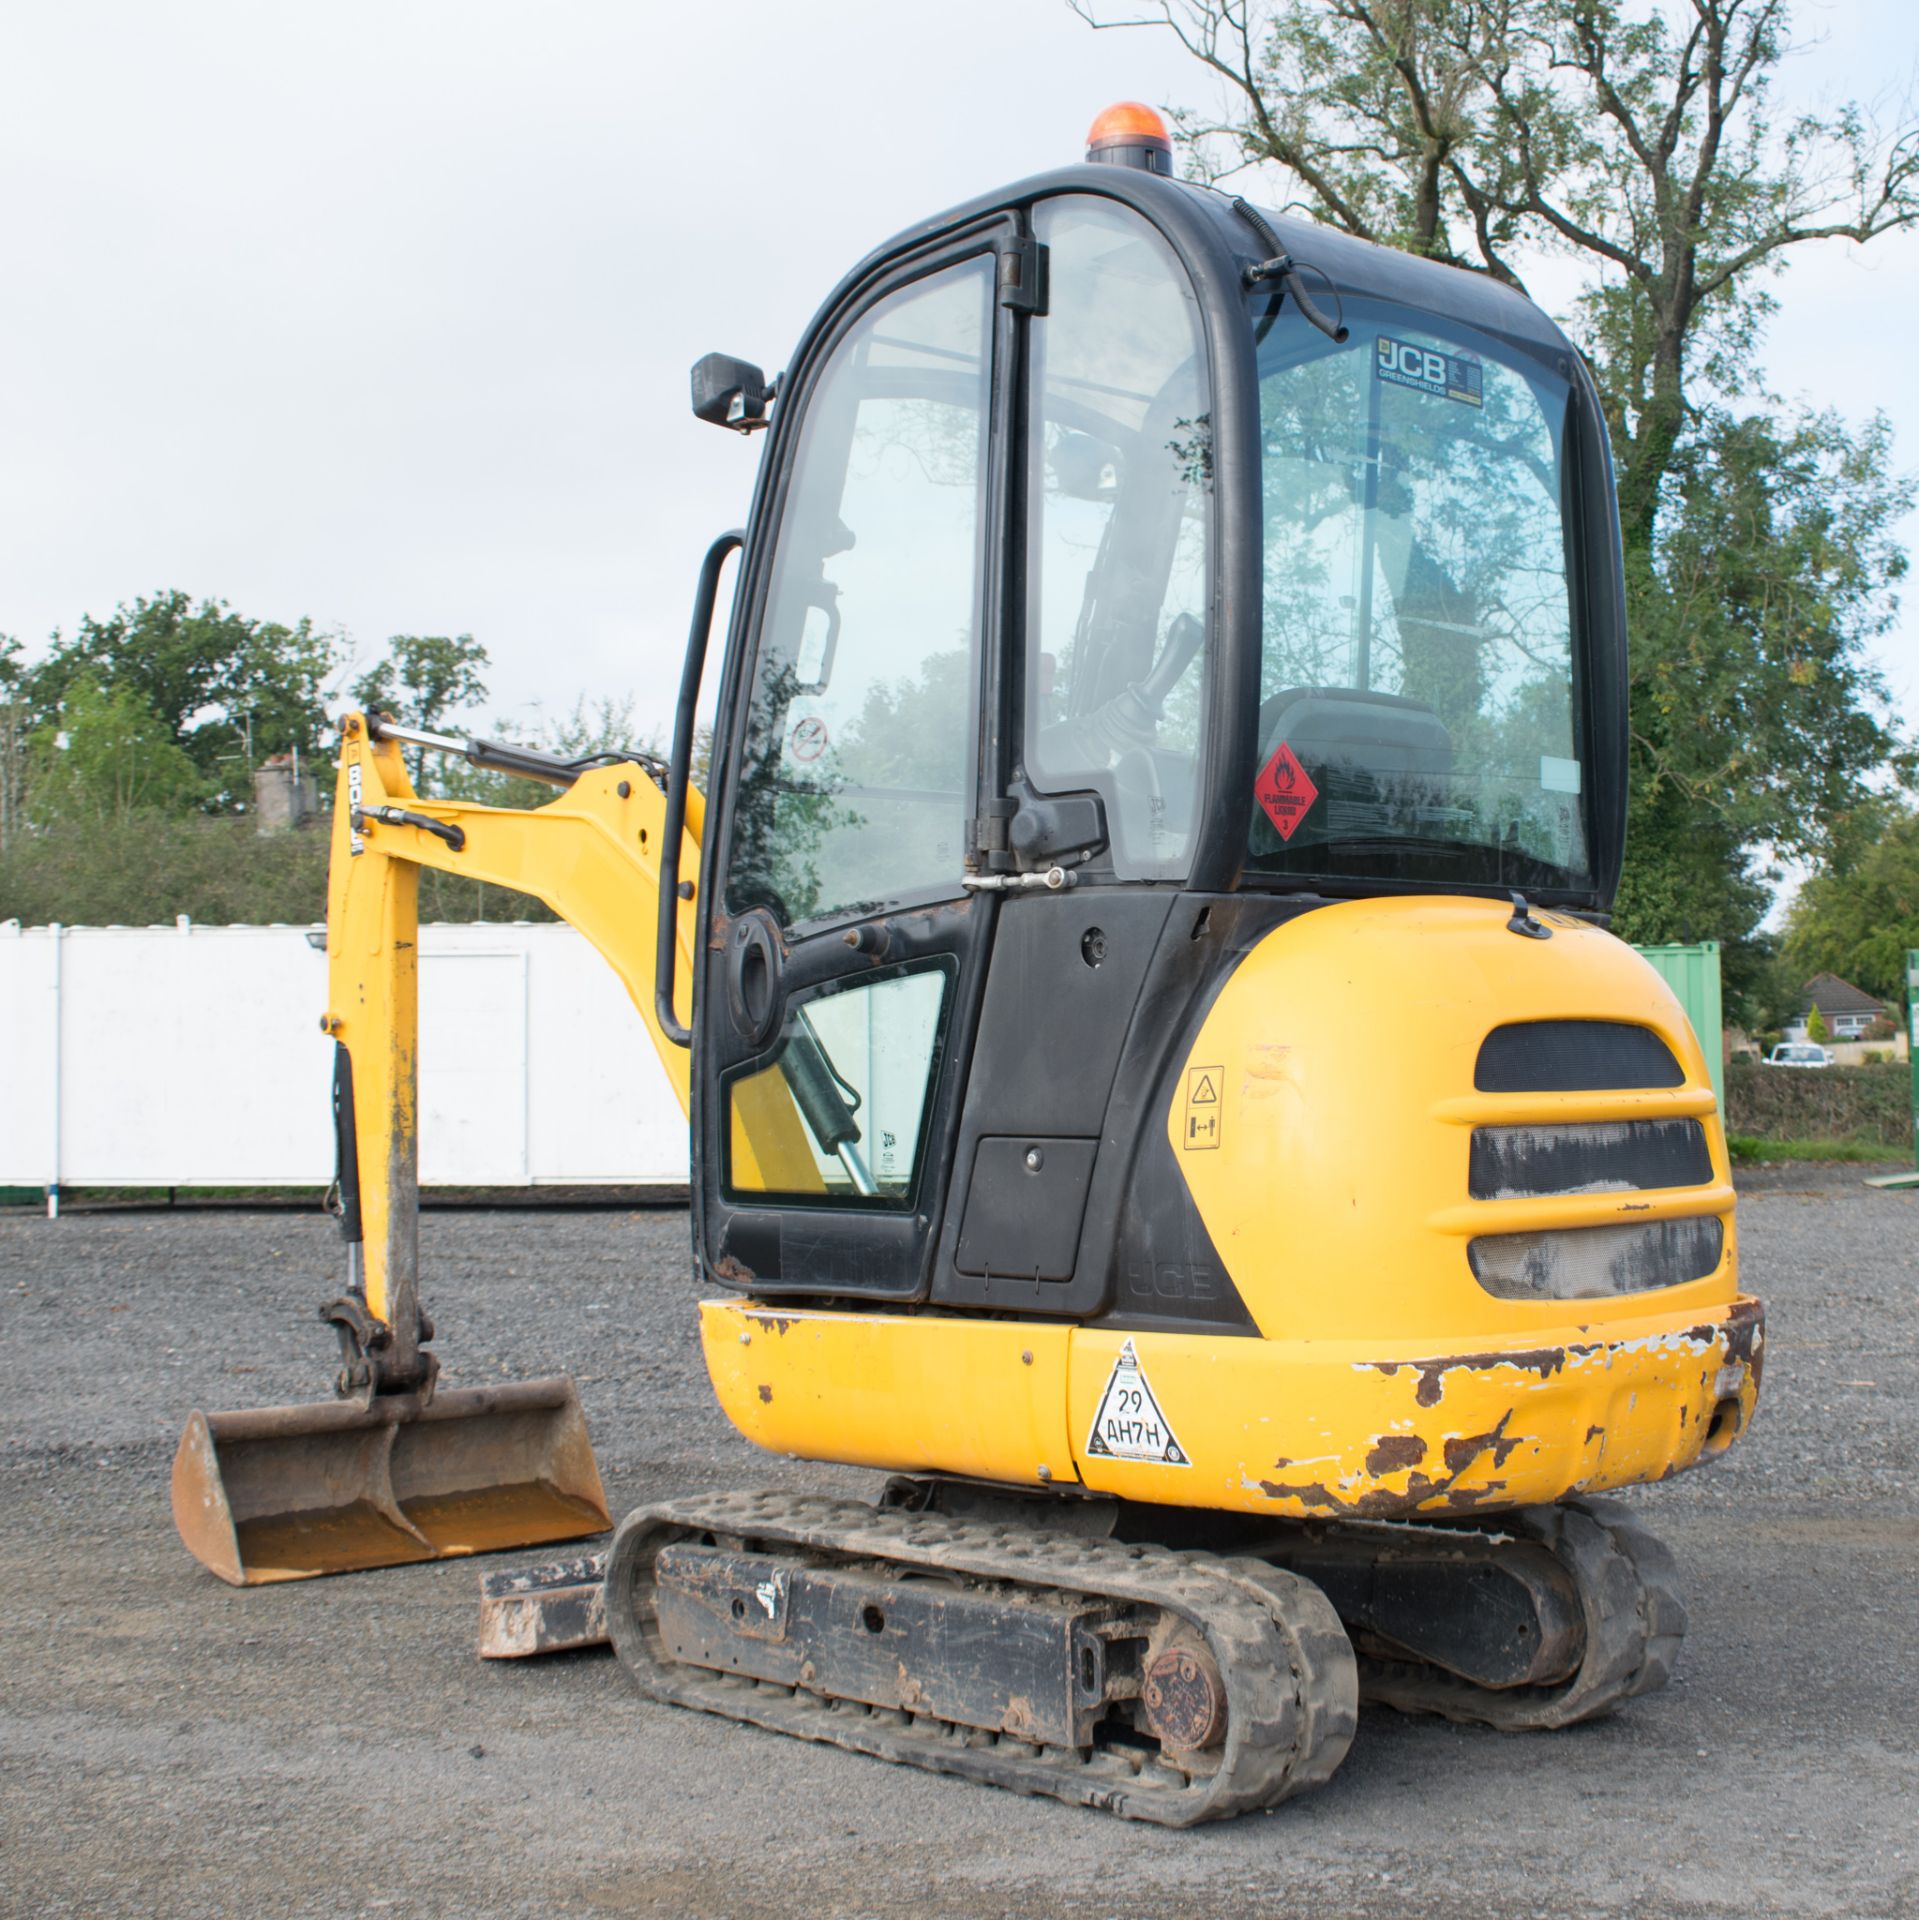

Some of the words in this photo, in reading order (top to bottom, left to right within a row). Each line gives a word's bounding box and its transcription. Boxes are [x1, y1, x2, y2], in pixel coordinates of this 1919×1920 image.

[1379, 343, 1446, 385] JCB
[1379, 368, 1446, 395] GREENSHIELDS
[1264, 794, 1306, 806] FLAMMABLE
[1118, 1389, 1143, 1414] 29
[1107, 1419, 1160, 1447] AH7H
